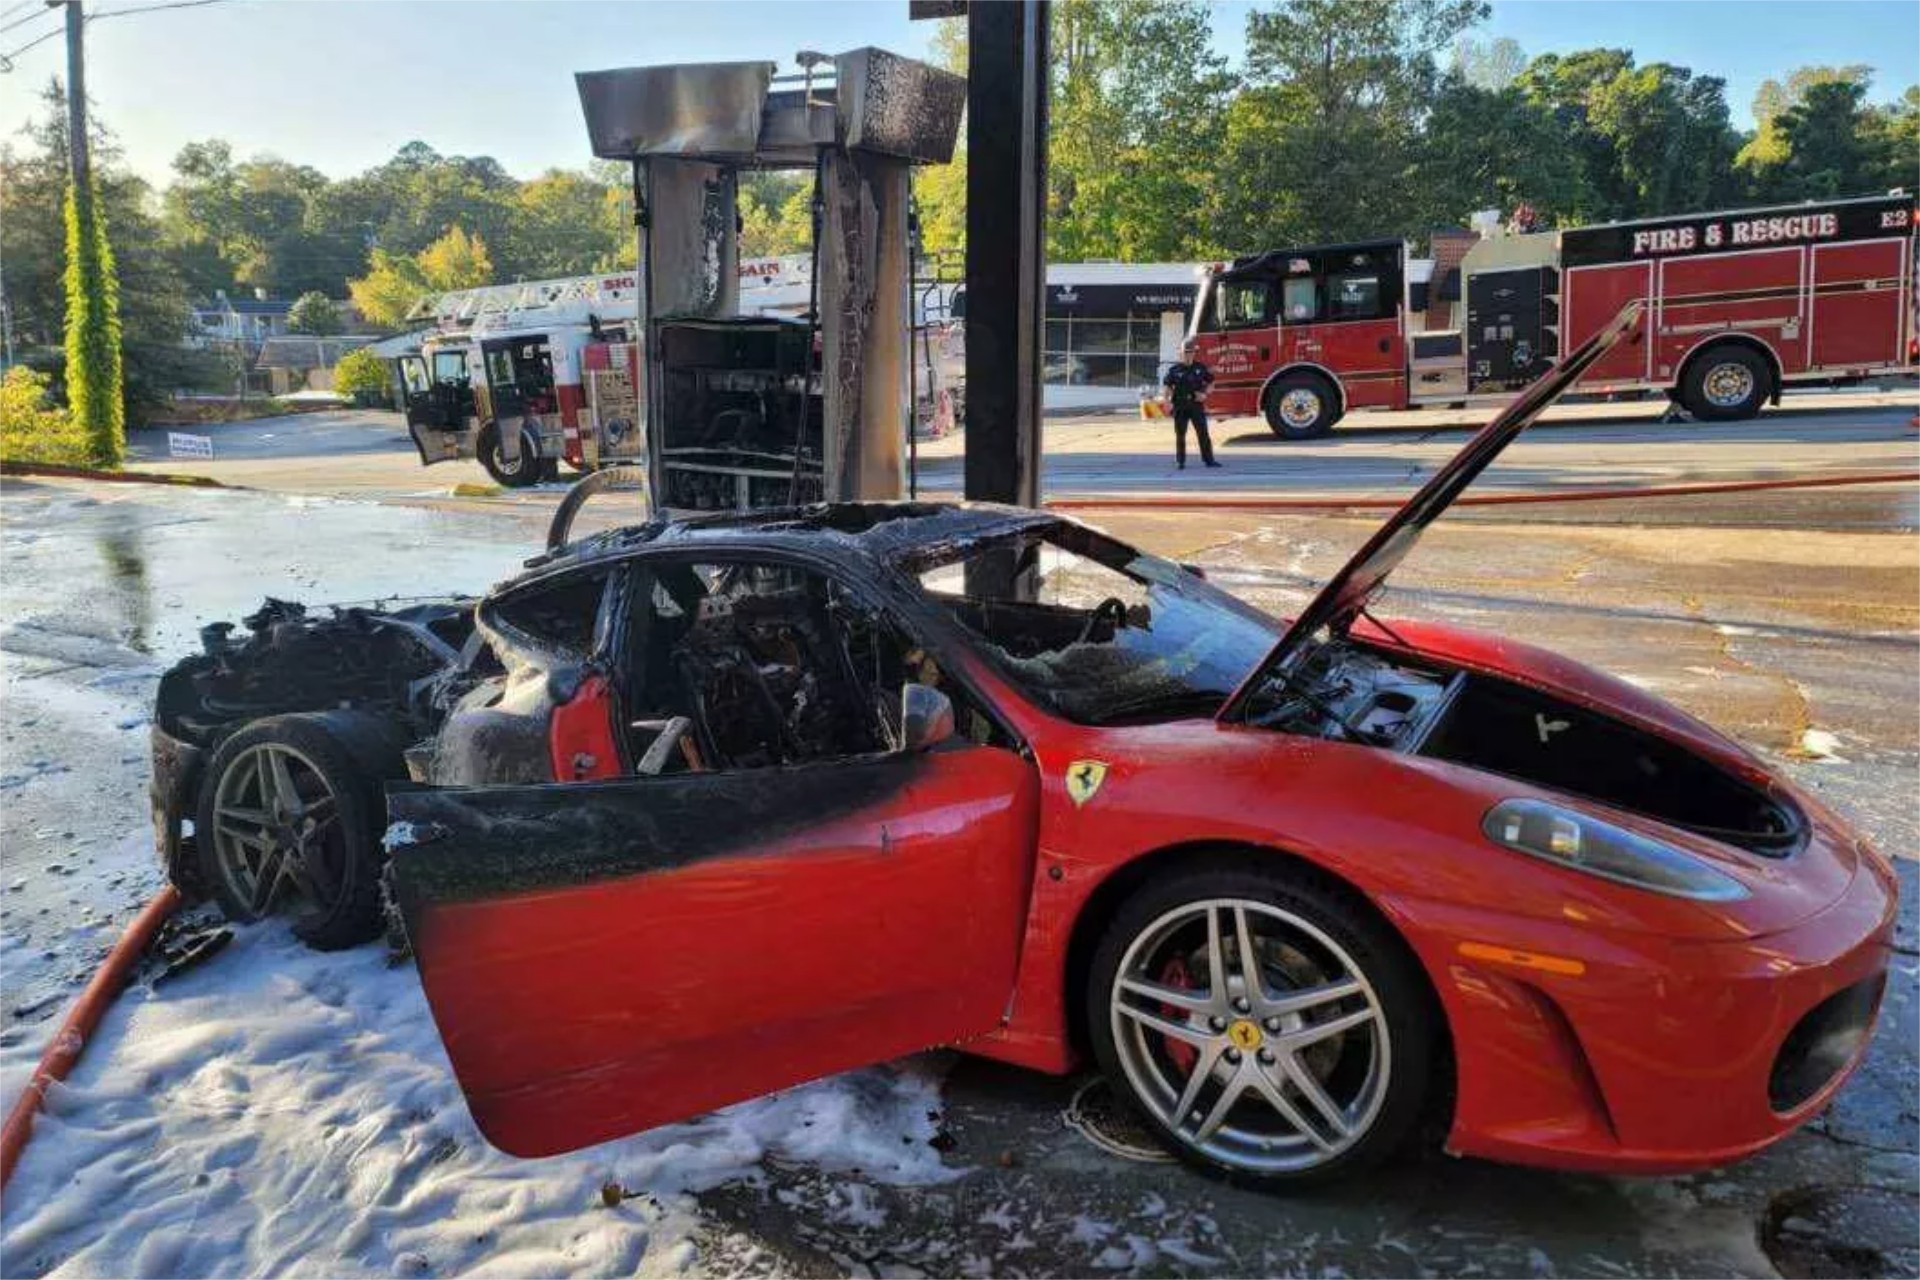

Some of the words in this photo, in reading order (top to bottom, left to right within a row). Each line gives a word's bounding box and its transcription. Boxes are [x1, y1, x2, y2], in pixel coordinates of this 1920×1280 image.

[1880, 210, 1909, 228] E2
[1633, 227, 1697, 254] FIRE
[1732, 213, 1839, 244] RESCUE
[602, 276, 636, 291] SIG
